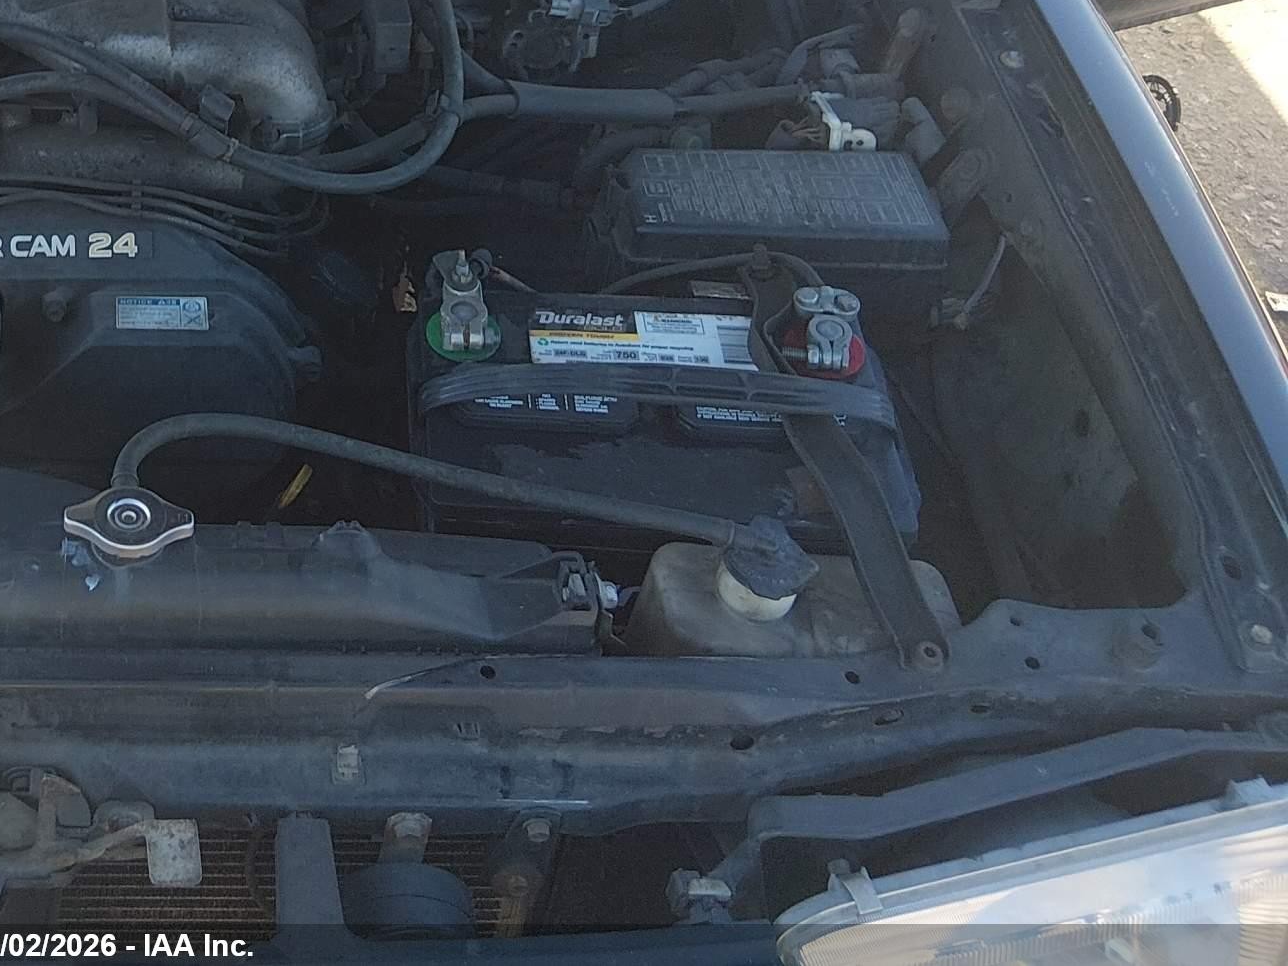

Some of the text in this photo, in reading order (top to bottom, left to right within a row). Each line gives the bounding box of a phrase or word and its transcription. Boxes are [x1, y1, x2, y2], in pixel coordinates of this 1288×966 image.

[10, 234, 76, 258] CAM
[87, 232, 138, 259] 24
[535, 310, 623, 327] Duralast
[615, 351, 638, 359] 750
